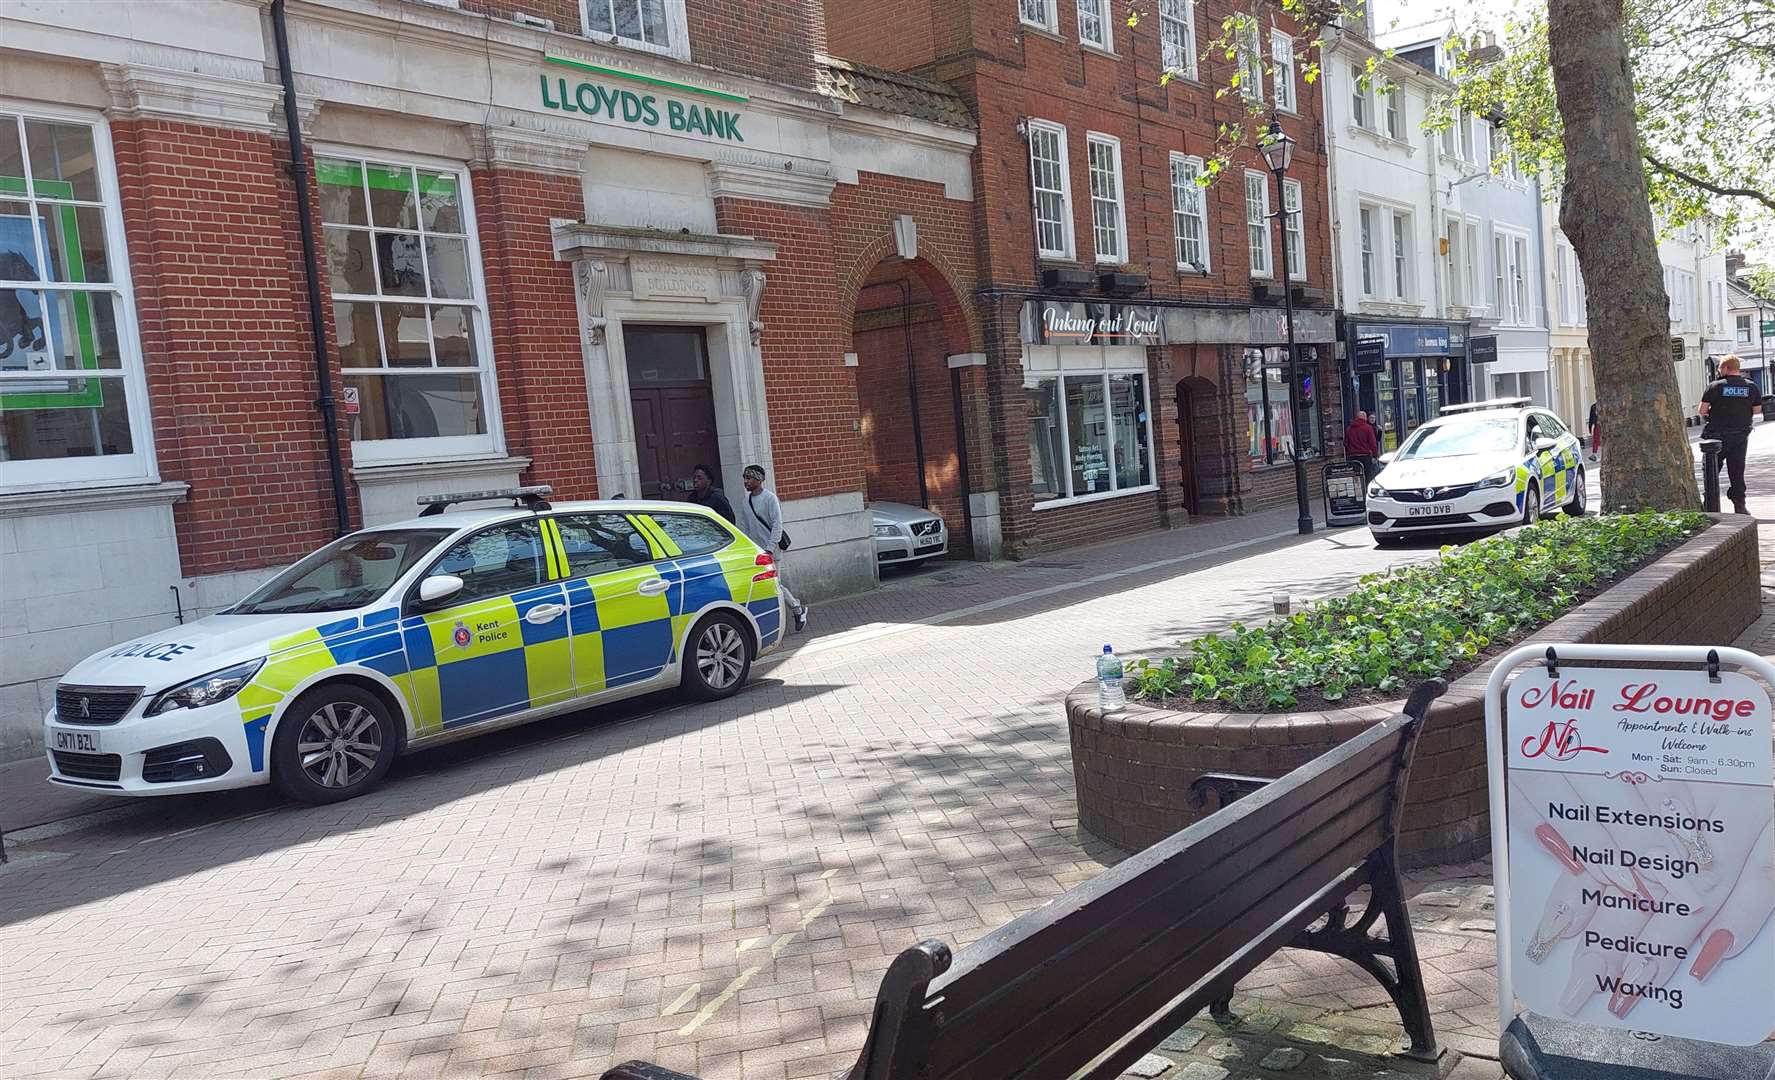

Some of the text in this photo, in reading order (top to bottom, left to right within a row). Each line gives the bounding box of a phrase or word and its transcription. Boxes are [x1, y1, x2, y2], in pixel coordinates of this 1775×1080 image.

[540, 74, 744, 142] LLOYDS BANK
[1043, 307, 1158, 343] Inking out Loud
[1723, 387, 1748, 396] POLICE
[1409, 504, 1451, 516] GN70 DVB
[476, 620, 500, 632] Kent
[479, 631, 508, 643] Police
[1520, 680, 1756, 721] Nail Lounge
[1617, 717, 1689, 734] Appointments
[1700, 724, 1753, 737] Walk-ins
[57, 732, 97, 751] GN71 BZL
[1661, 736, 1708, 752] Welcome
[1631, 752, 1654, 763] Mon
[1662, 754, 1683, 764] Sat:
[1687, 756, 1709, 765] 9am
[1660, 763, 1718, 776] Sun: Closed
[1549, 802, 1725, 834] Nail Extensions
[1572, 846, 1700, 879] Nail Design
[1582, 888, 1690, 917] Manicure
[1585, 931, 1688, 960] Pedicure
[1596, 974, 1683, 1010] Waxing
